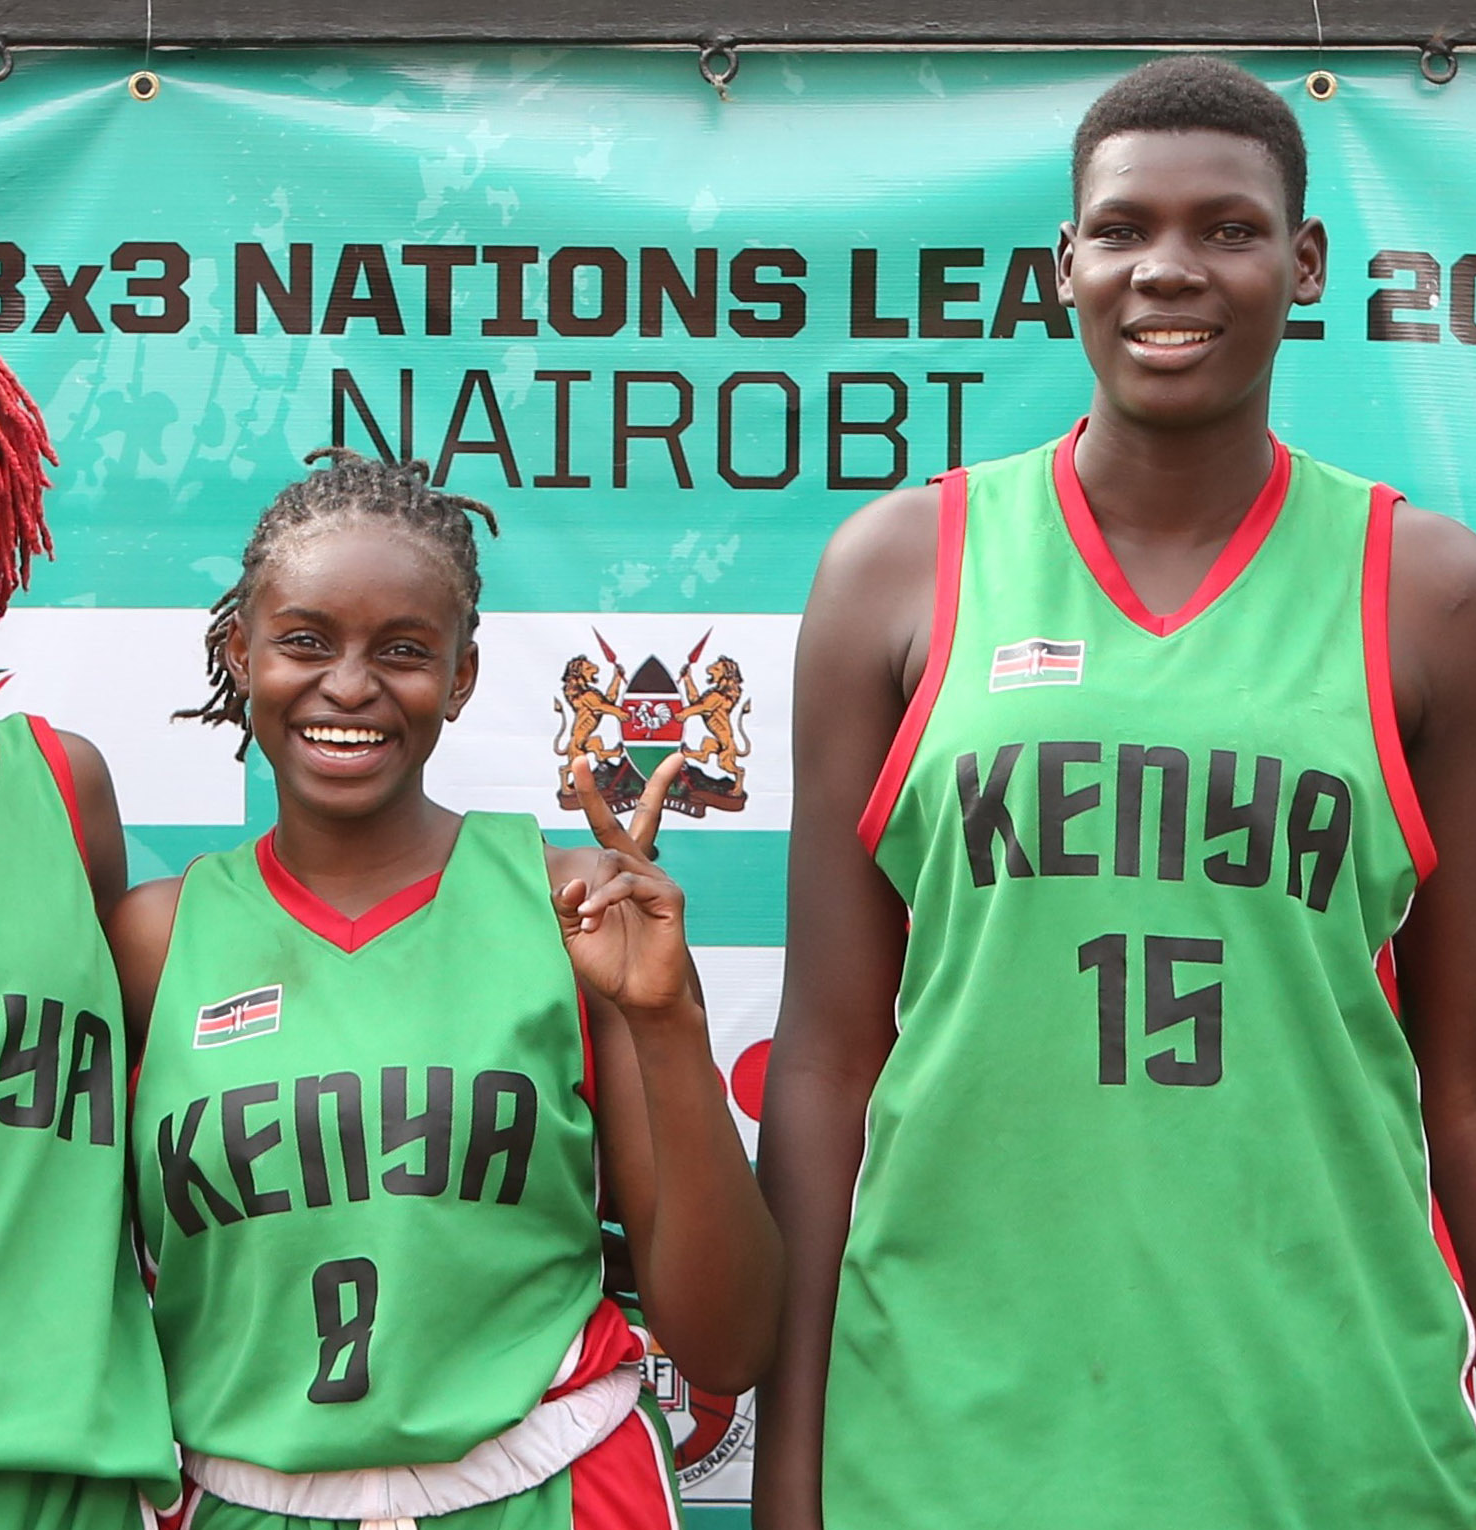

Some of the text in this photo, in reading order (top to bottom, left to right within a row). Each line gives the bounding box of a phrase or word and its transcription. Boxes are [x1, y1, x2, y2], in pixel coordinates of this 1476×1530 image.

[234, 242, 807, 339] NATIONS
[330, 367, 985, 491] NAIROBI
[955, 740, 1352, 914] KENYA
[1076, 932, 1224, 1087] 15
[157, 1065, 538, 1239] KENYA
[306, 1256, 379, 1405] 8
